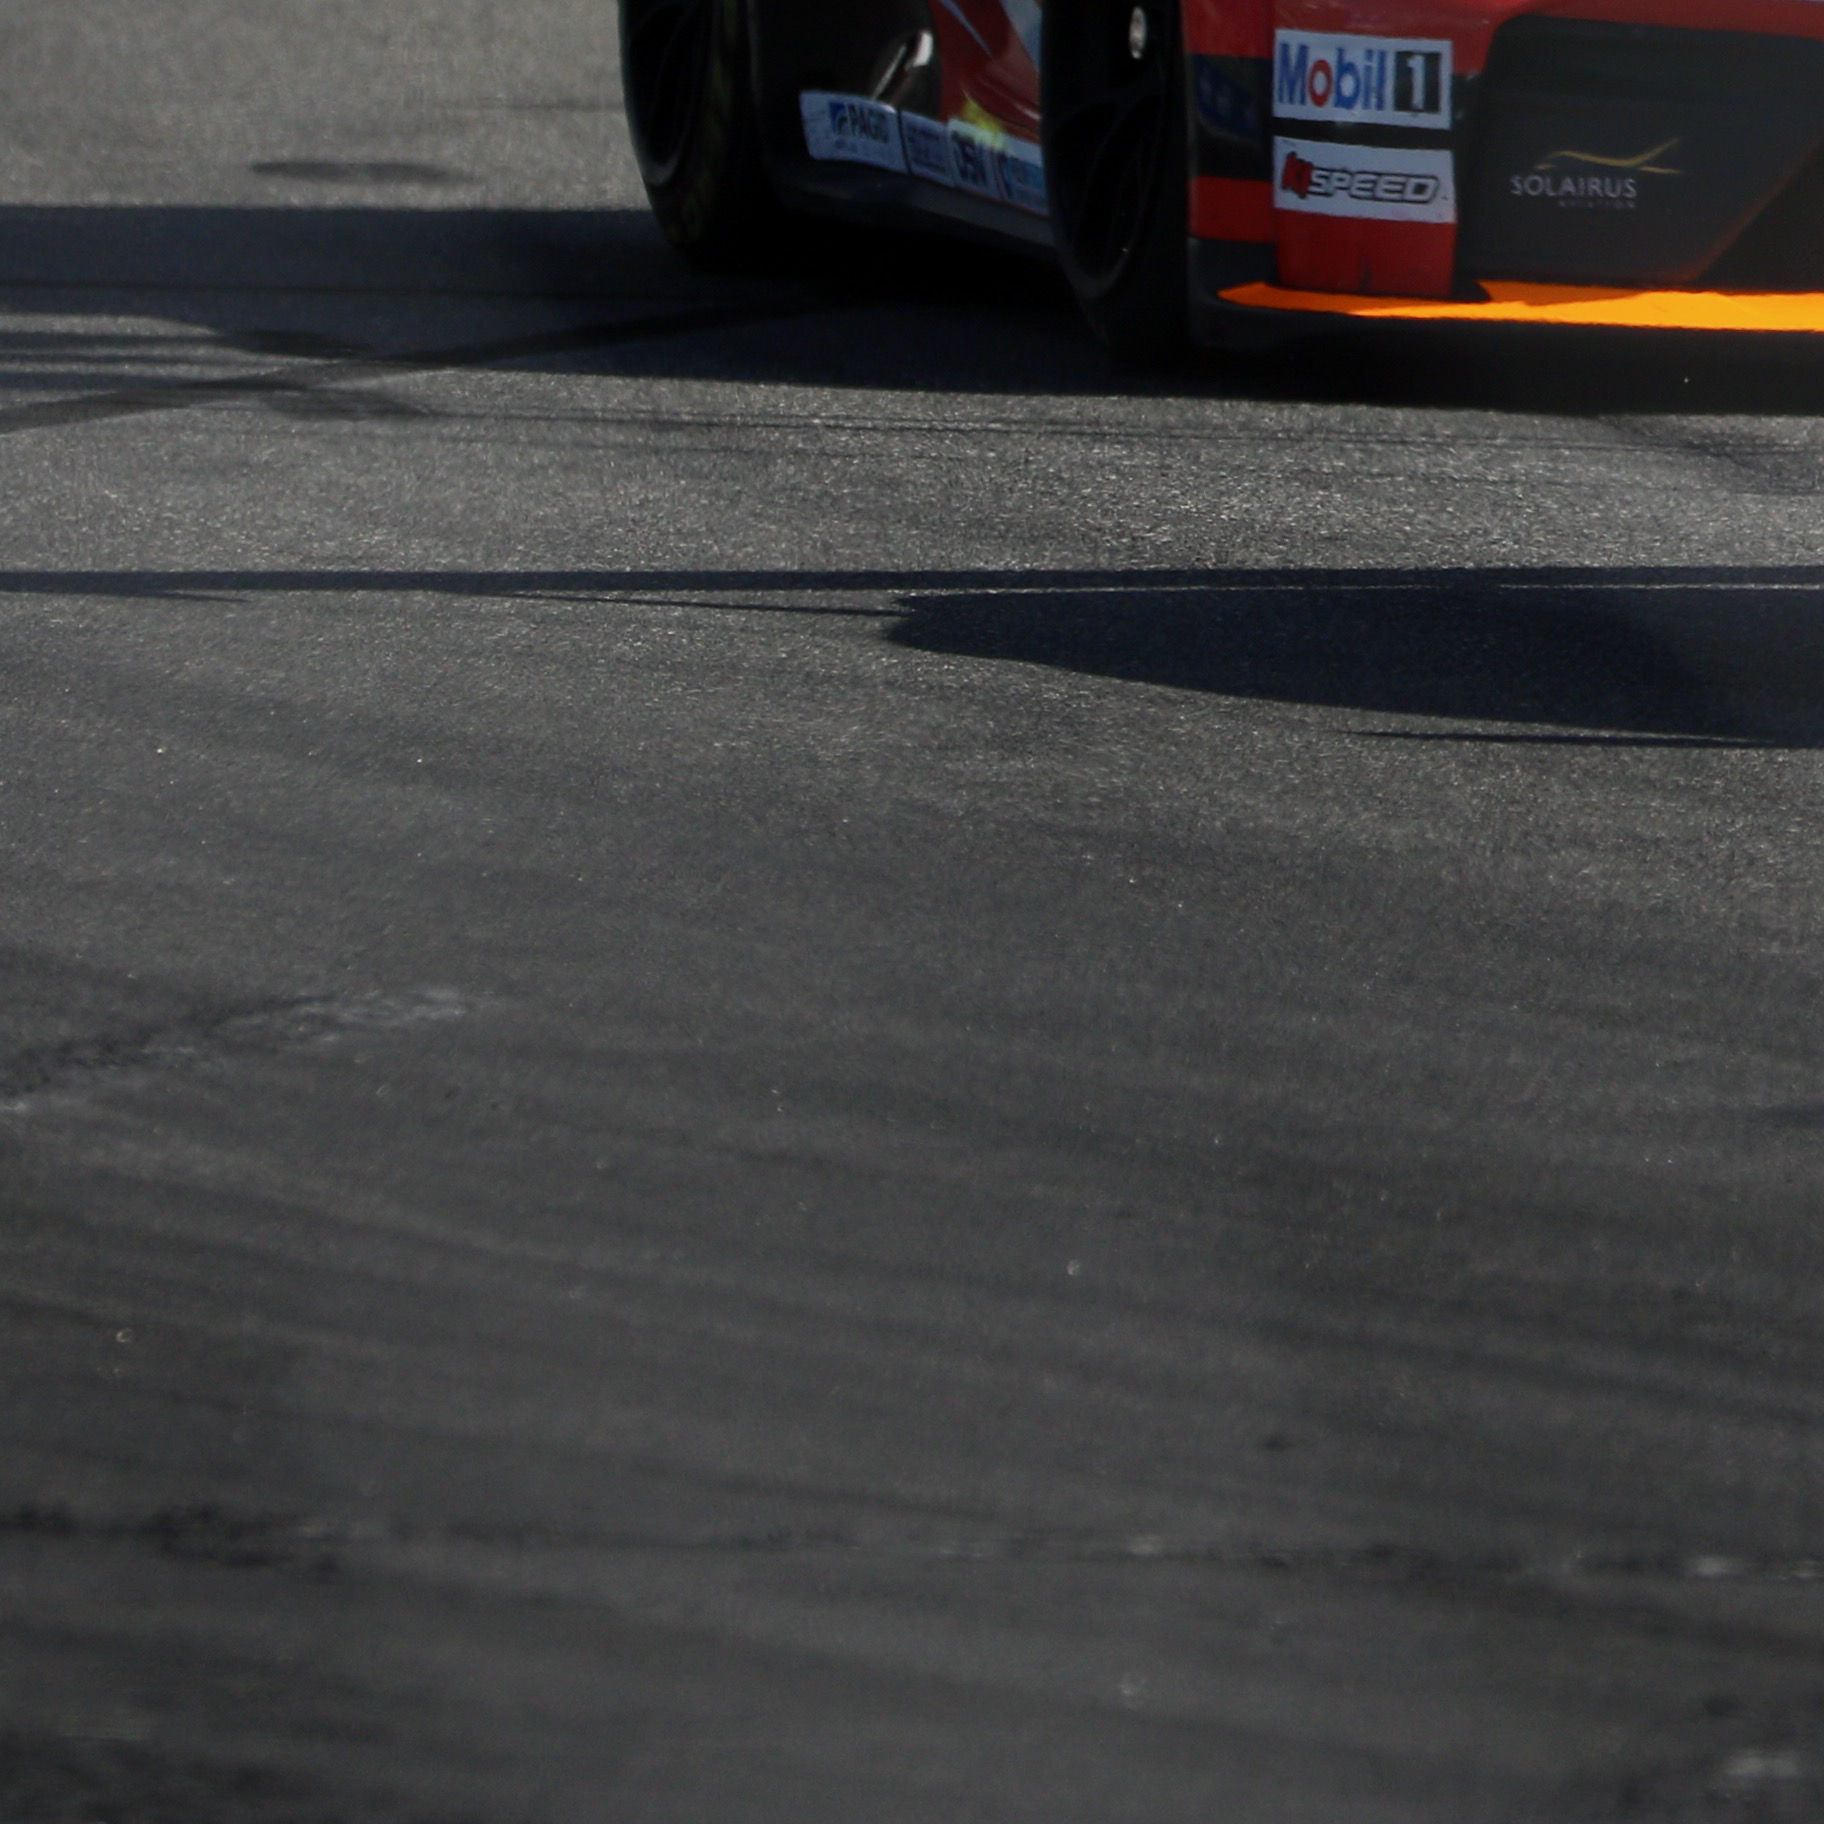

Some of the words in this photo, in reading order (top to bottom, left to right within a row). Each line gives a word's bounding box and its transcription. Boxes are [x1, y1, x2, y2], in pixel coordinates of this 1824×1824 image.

[1275, 41, 1388, 113] Mobil
[1308, 167, 1441, 206] SPEED
[1510, 173, 1638, 200] SOLAIRUS
